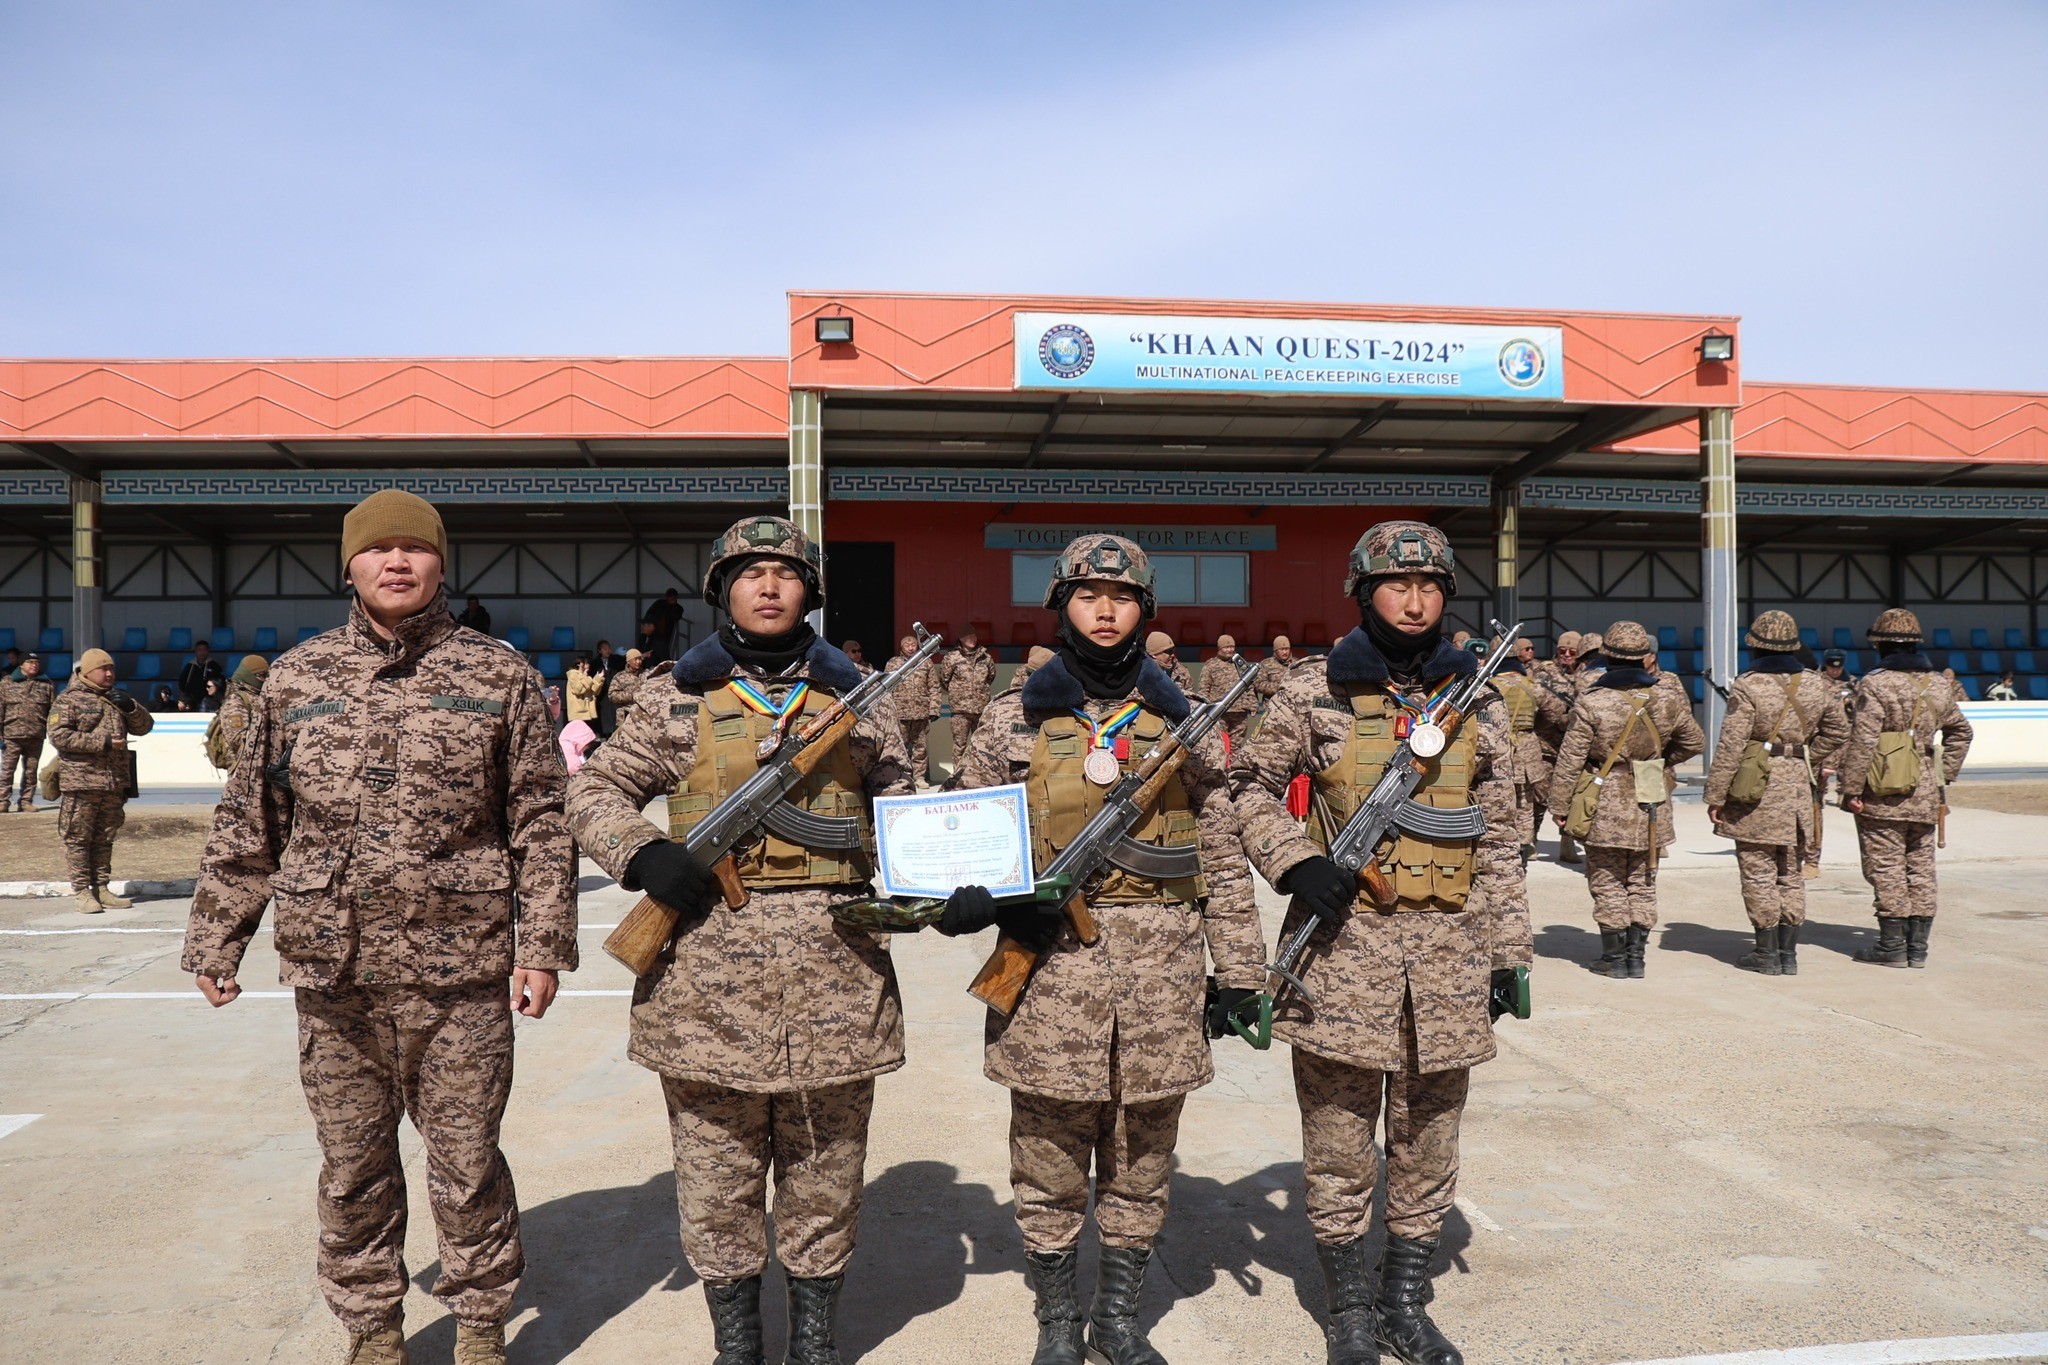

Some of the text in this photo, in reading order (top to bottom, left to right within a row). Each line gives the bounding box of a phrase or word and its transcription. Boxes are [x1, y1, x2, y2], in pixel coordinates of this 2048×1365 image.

[1129, 332, 1465, 363] “KHAAN QUEST-2024”
[1136, 366, 1460, 385] MULTINATIONAL PEACEKEEPING EXERCISE
[1136, 530, 1175, 545] FOR
[1184, 531, 1250, 545] PEACE
[451, 699, 485, 711] ХЗЦК
[925, 802, 979, 815] БАТЛАМЖ
